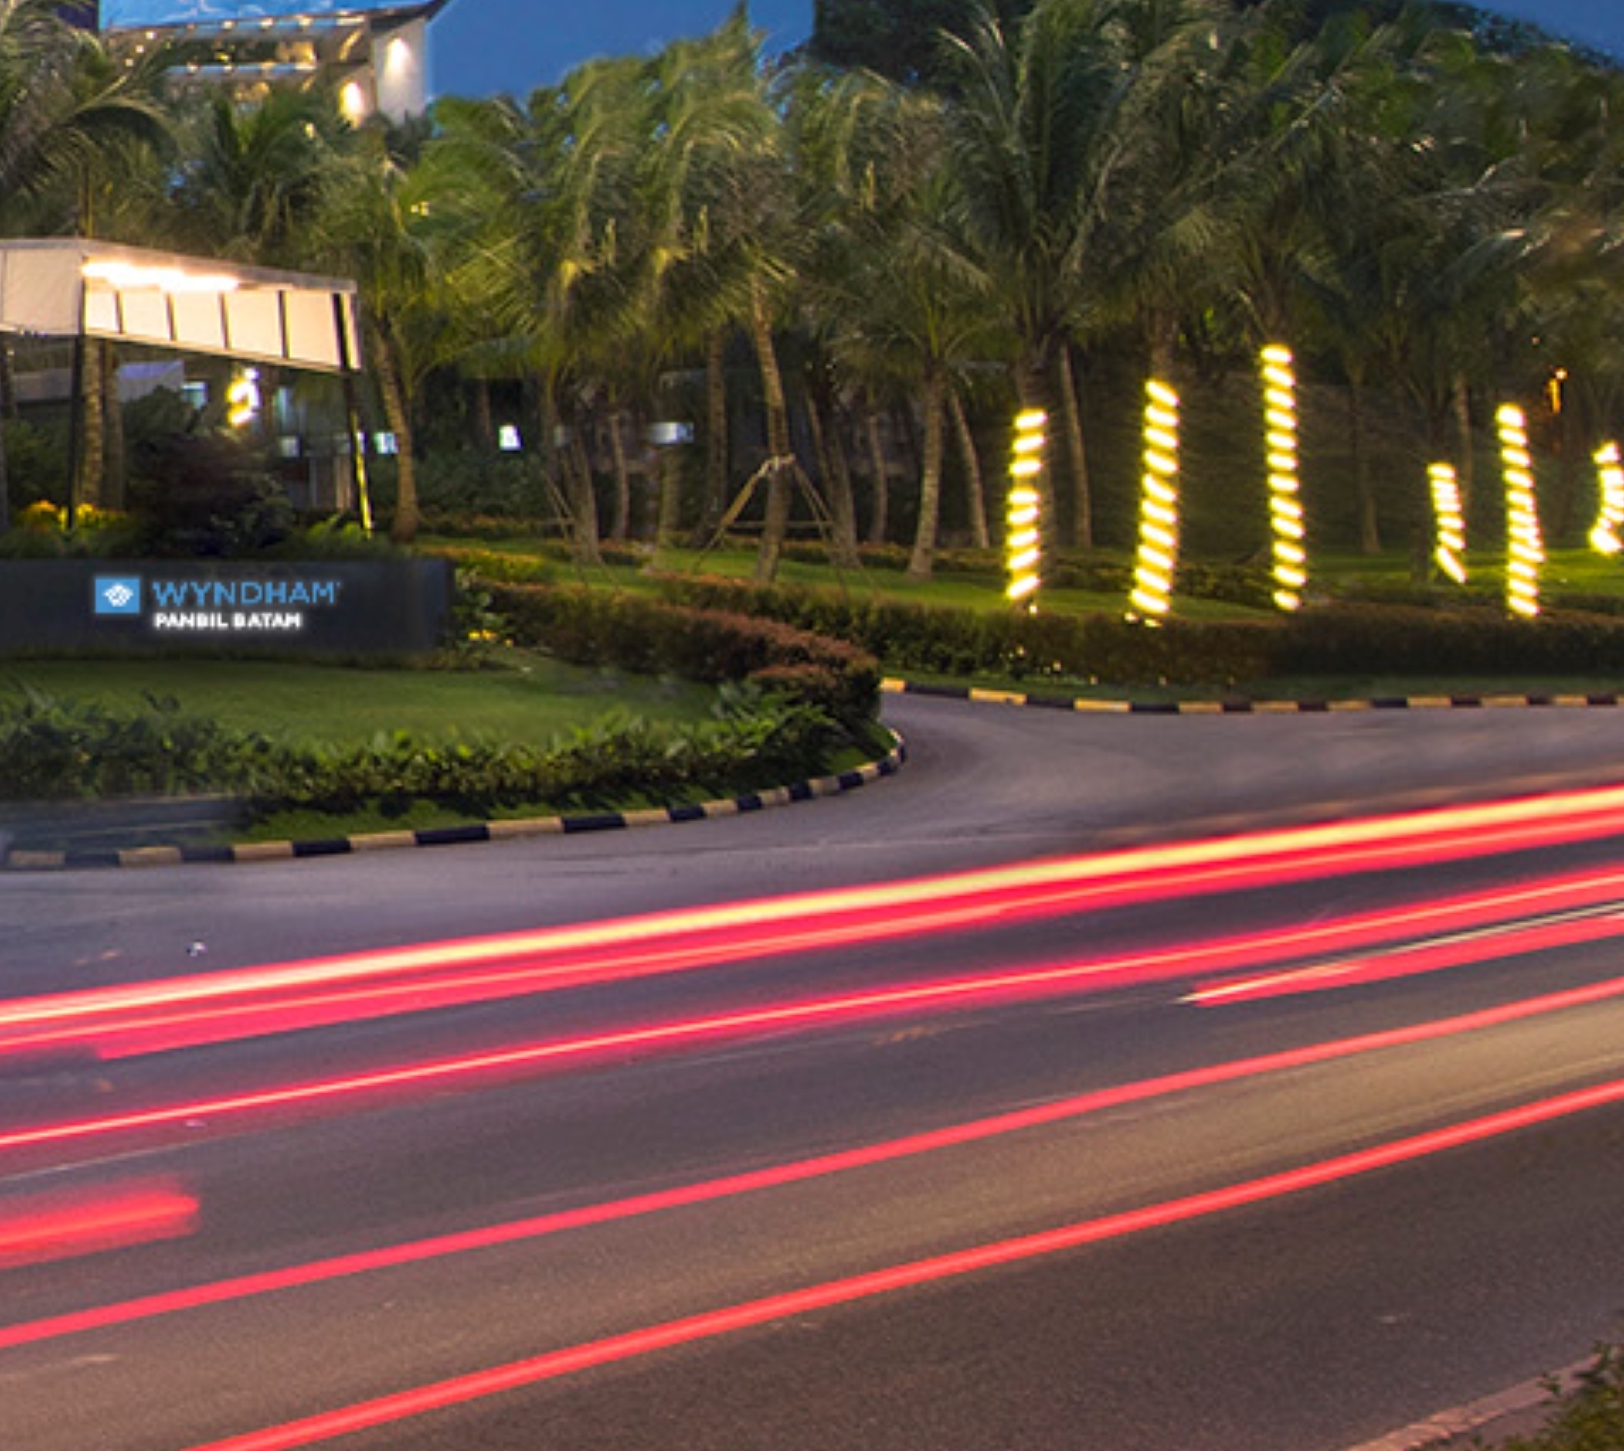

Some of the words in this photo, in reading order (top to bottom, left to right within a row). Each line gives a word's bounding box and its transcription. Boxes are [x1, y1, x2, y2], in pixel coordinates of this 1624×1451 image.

[153, 582, 334, 606] WYNDHAM
[155, 612, 228, 629] PANBIL
[233, 612, 301, 629] BATAM
